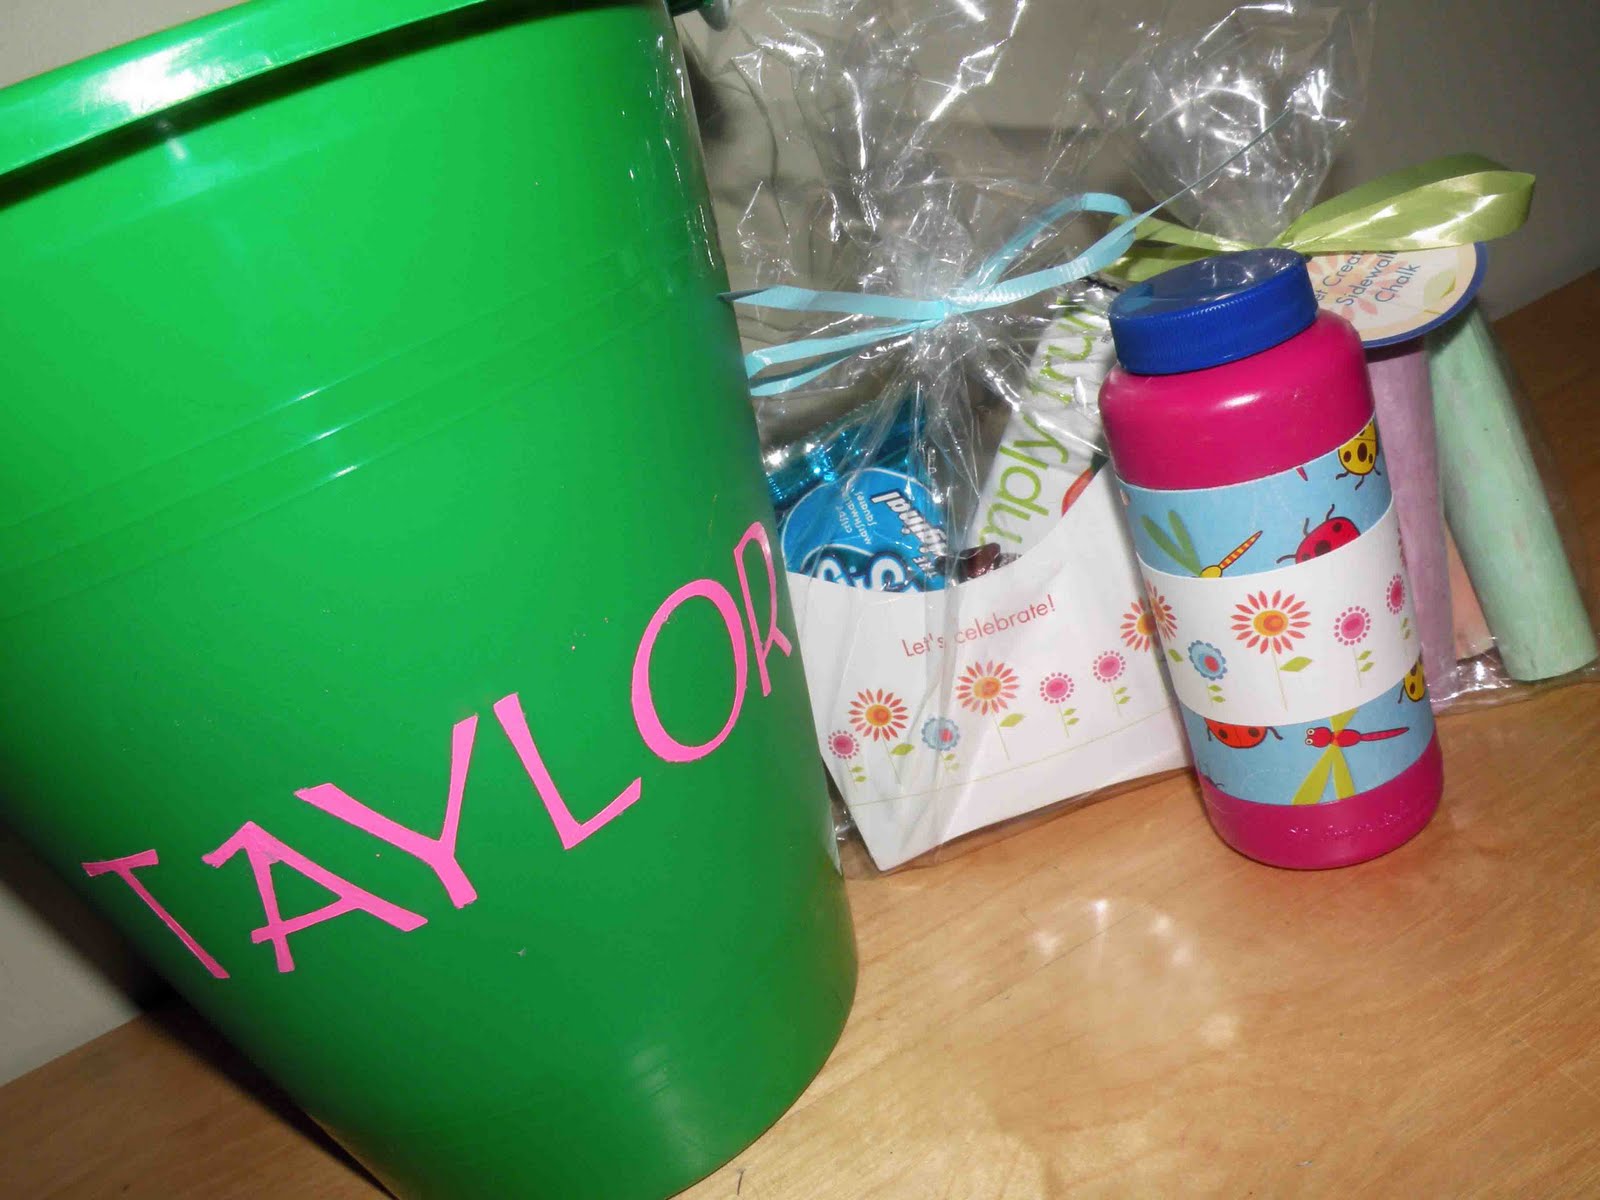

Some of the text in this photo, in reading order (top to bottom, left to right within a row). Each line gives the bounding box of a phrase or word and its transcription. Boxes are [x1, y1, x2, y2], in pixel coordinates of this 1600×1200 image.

[1376, 264, 1421, 302] Chalk
[902, 594, 1056, 657] Let's celebrate!
[82, 521, 793, 980] TAYLOR
